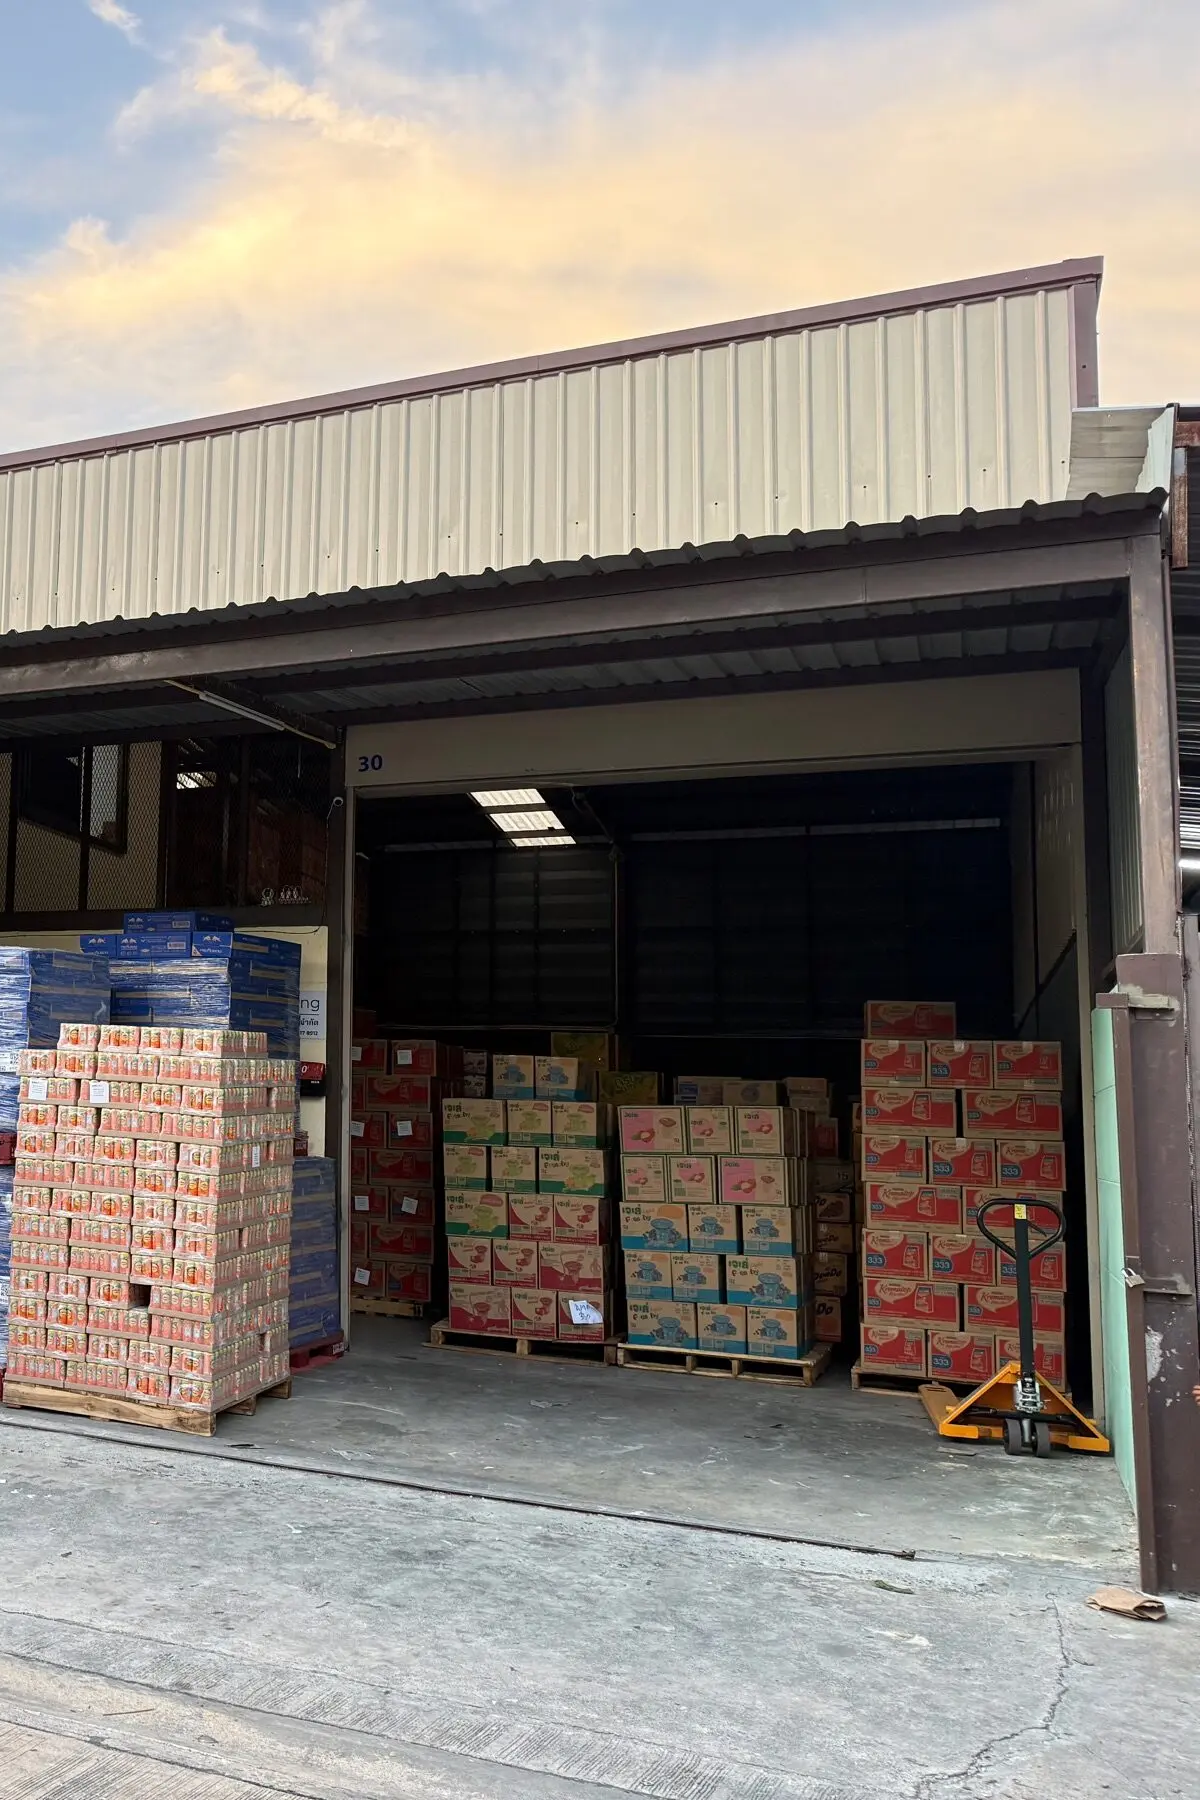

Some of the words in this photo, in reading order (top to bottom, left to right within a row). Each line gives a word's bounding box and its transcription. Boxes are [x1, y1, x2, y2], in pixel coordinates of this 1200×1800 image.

[358, 754, 383, 773] 30
[867, 1256, 883, 1265] 333
[934, 1261, 950, 1270] 333
[933, 1358, 949, 1367] 333
